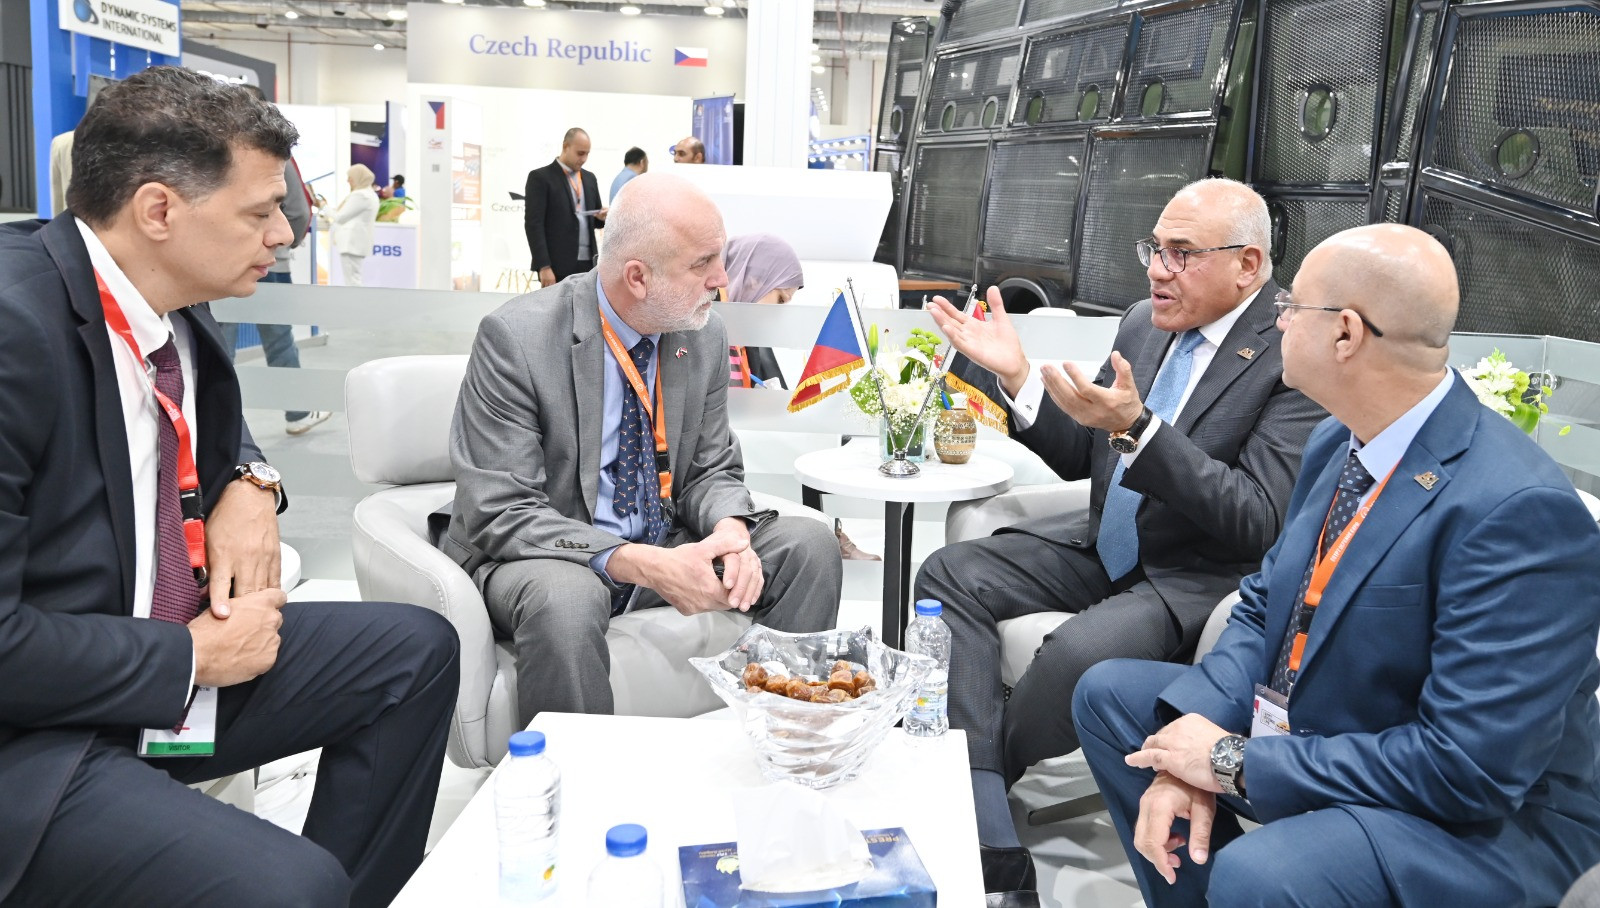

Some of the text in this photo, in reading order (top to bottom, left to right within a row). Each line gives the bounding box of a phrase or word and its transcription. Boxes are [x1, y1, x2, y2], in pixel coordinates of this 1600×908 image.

[101, 2, 177, 32] DYNAMIC SYSTEMS
[103, 18, 163, 44] INTERNATIONAL
[469, 34, 652, 65] Czech Republic
[373, 245, 402, 256] PBS
